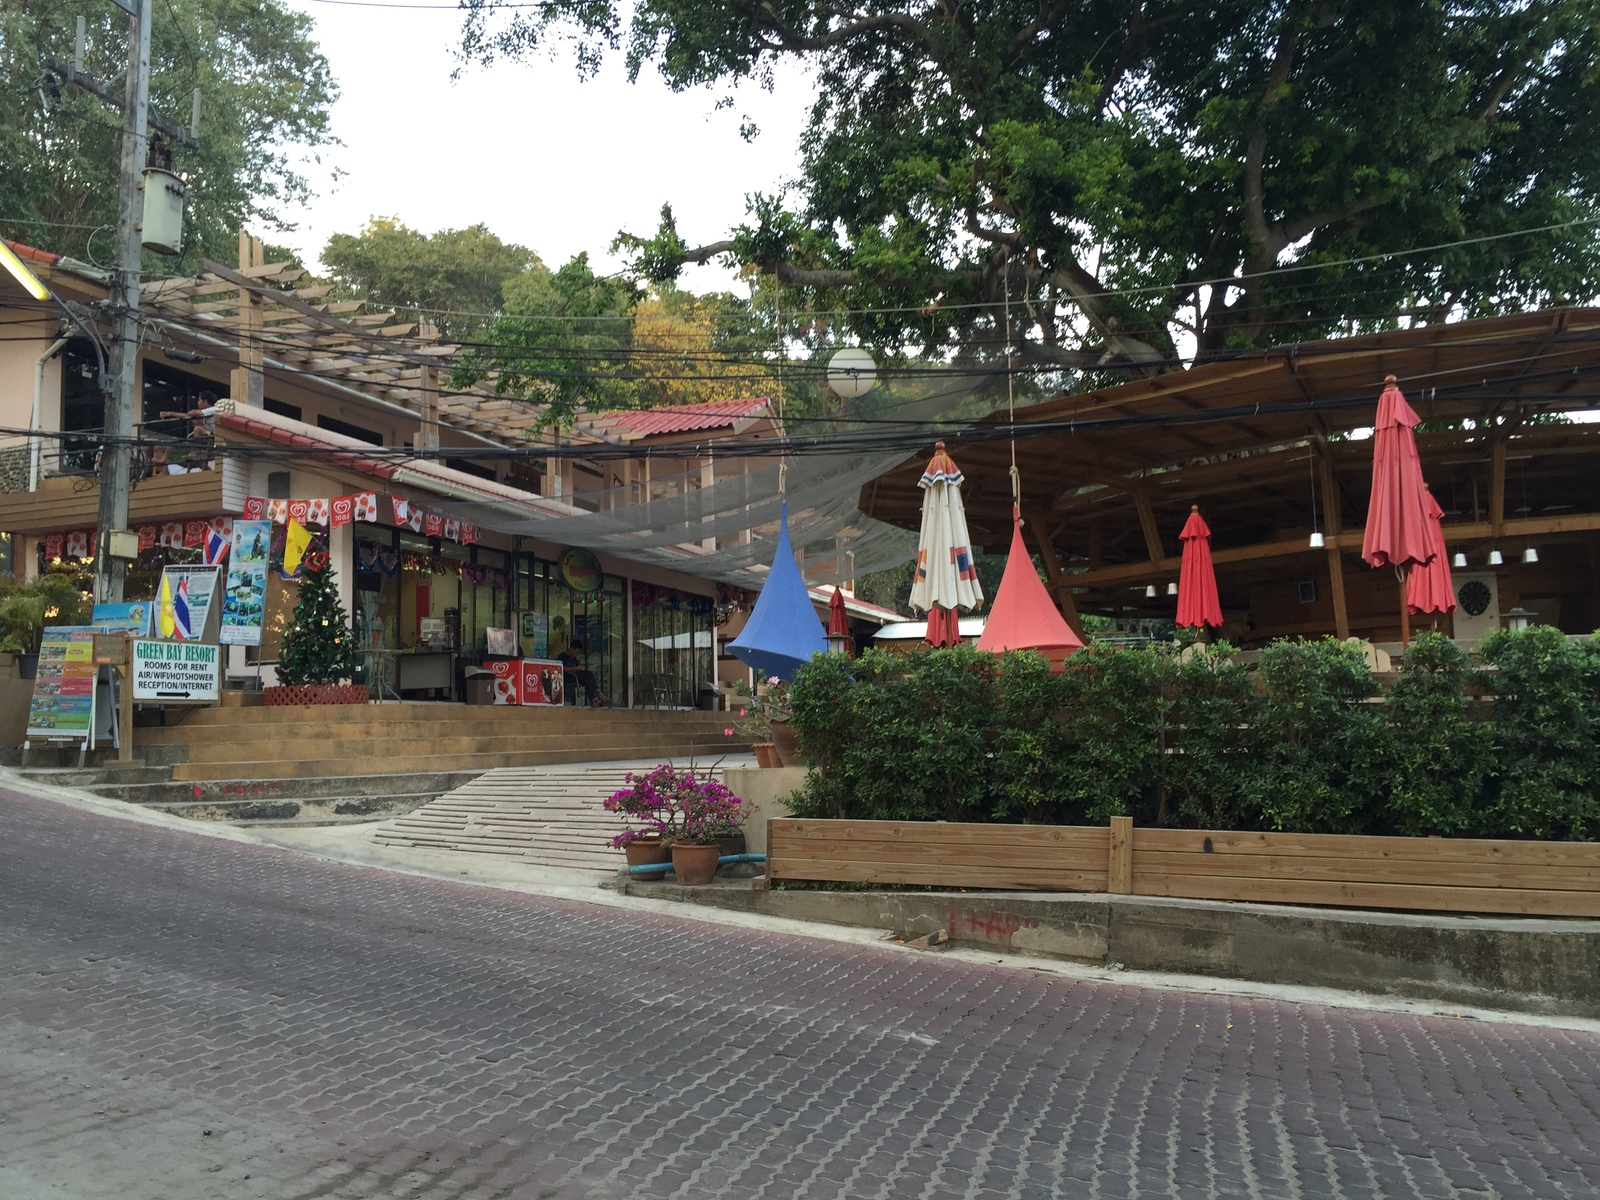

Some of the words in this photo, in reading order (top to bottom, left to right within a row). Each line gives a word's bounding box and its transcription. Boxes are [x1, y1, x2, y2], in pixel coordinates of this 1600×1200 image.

[136, 642, 165, 660] GREEN
[166, 644, 183, 660] BAY
[185, 645, 216, 663] RESORT
[144, 661, 171, 670] ROOMS
[174, 663, 188, 671] FOR
[190, 663, 208, 671] RENT
[138, 671, 214, 681] AIR/WIFI/HOTSHOWER
[138, 681, 213, 690] RECEPTION/INTERNET
